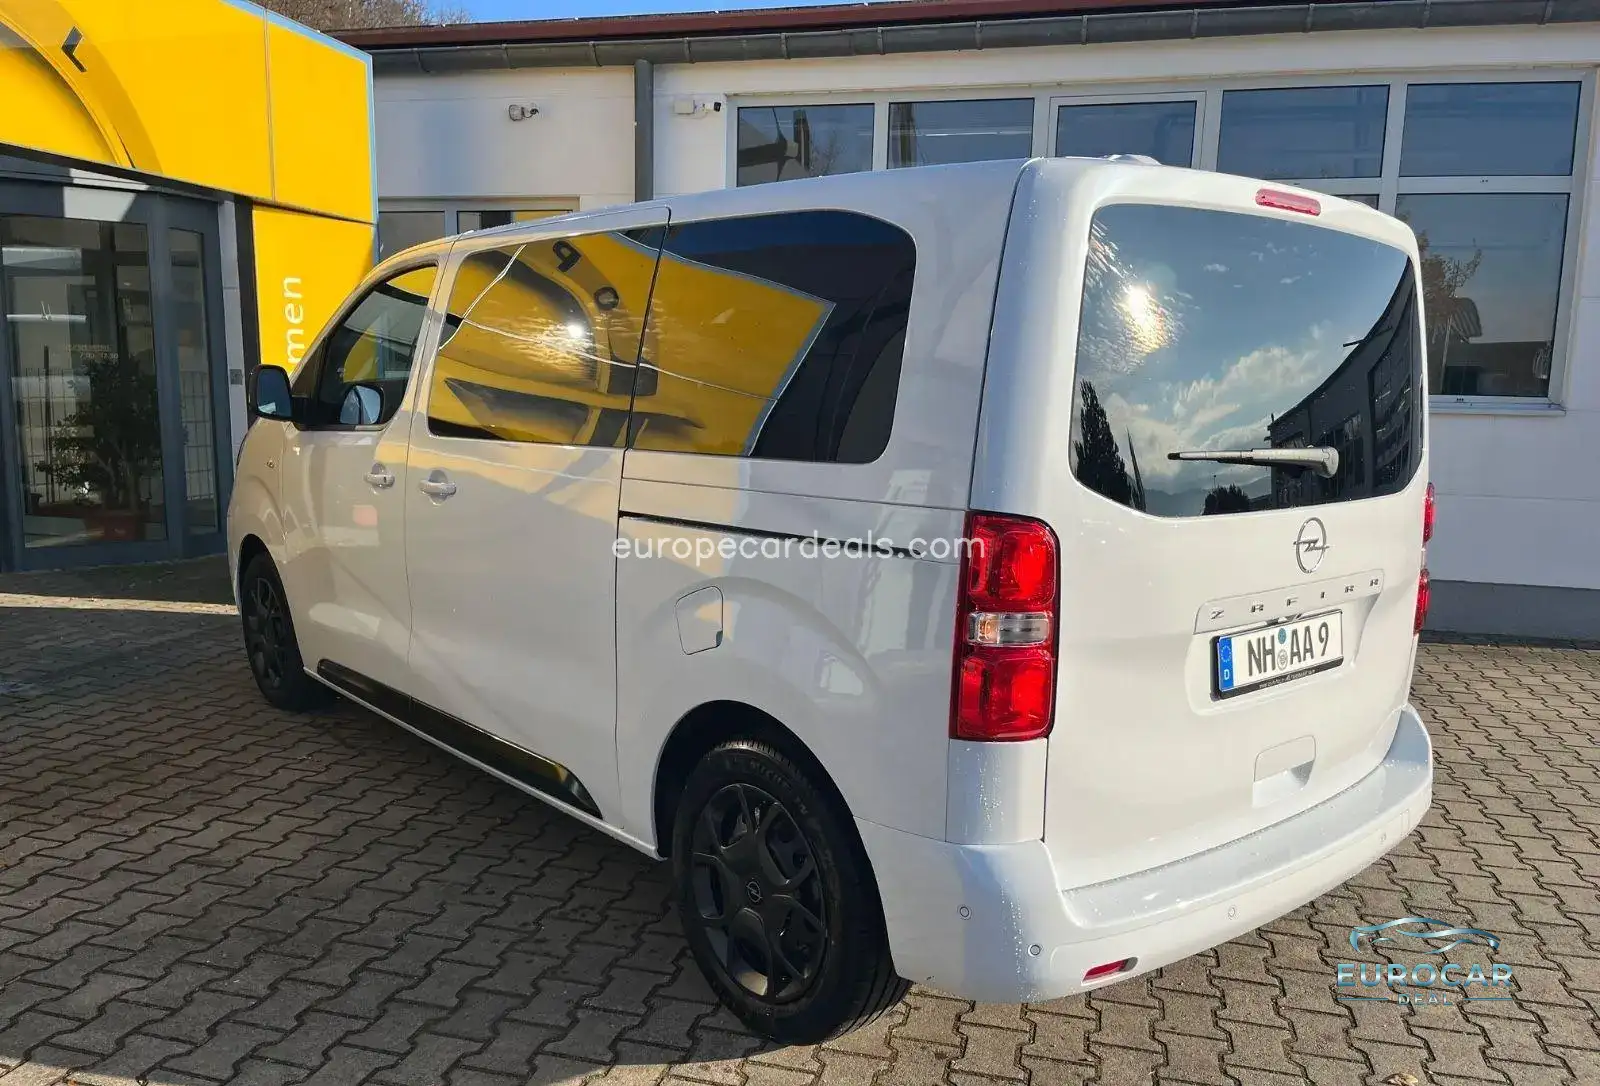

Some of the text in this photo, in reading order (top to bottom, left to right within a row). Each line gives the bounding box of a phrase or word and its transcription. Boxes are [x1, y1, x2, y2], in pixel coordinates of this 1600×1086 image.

[1247, 621, 1329, 677] NH AA 9
[1223, 669, 1230, 680] D
